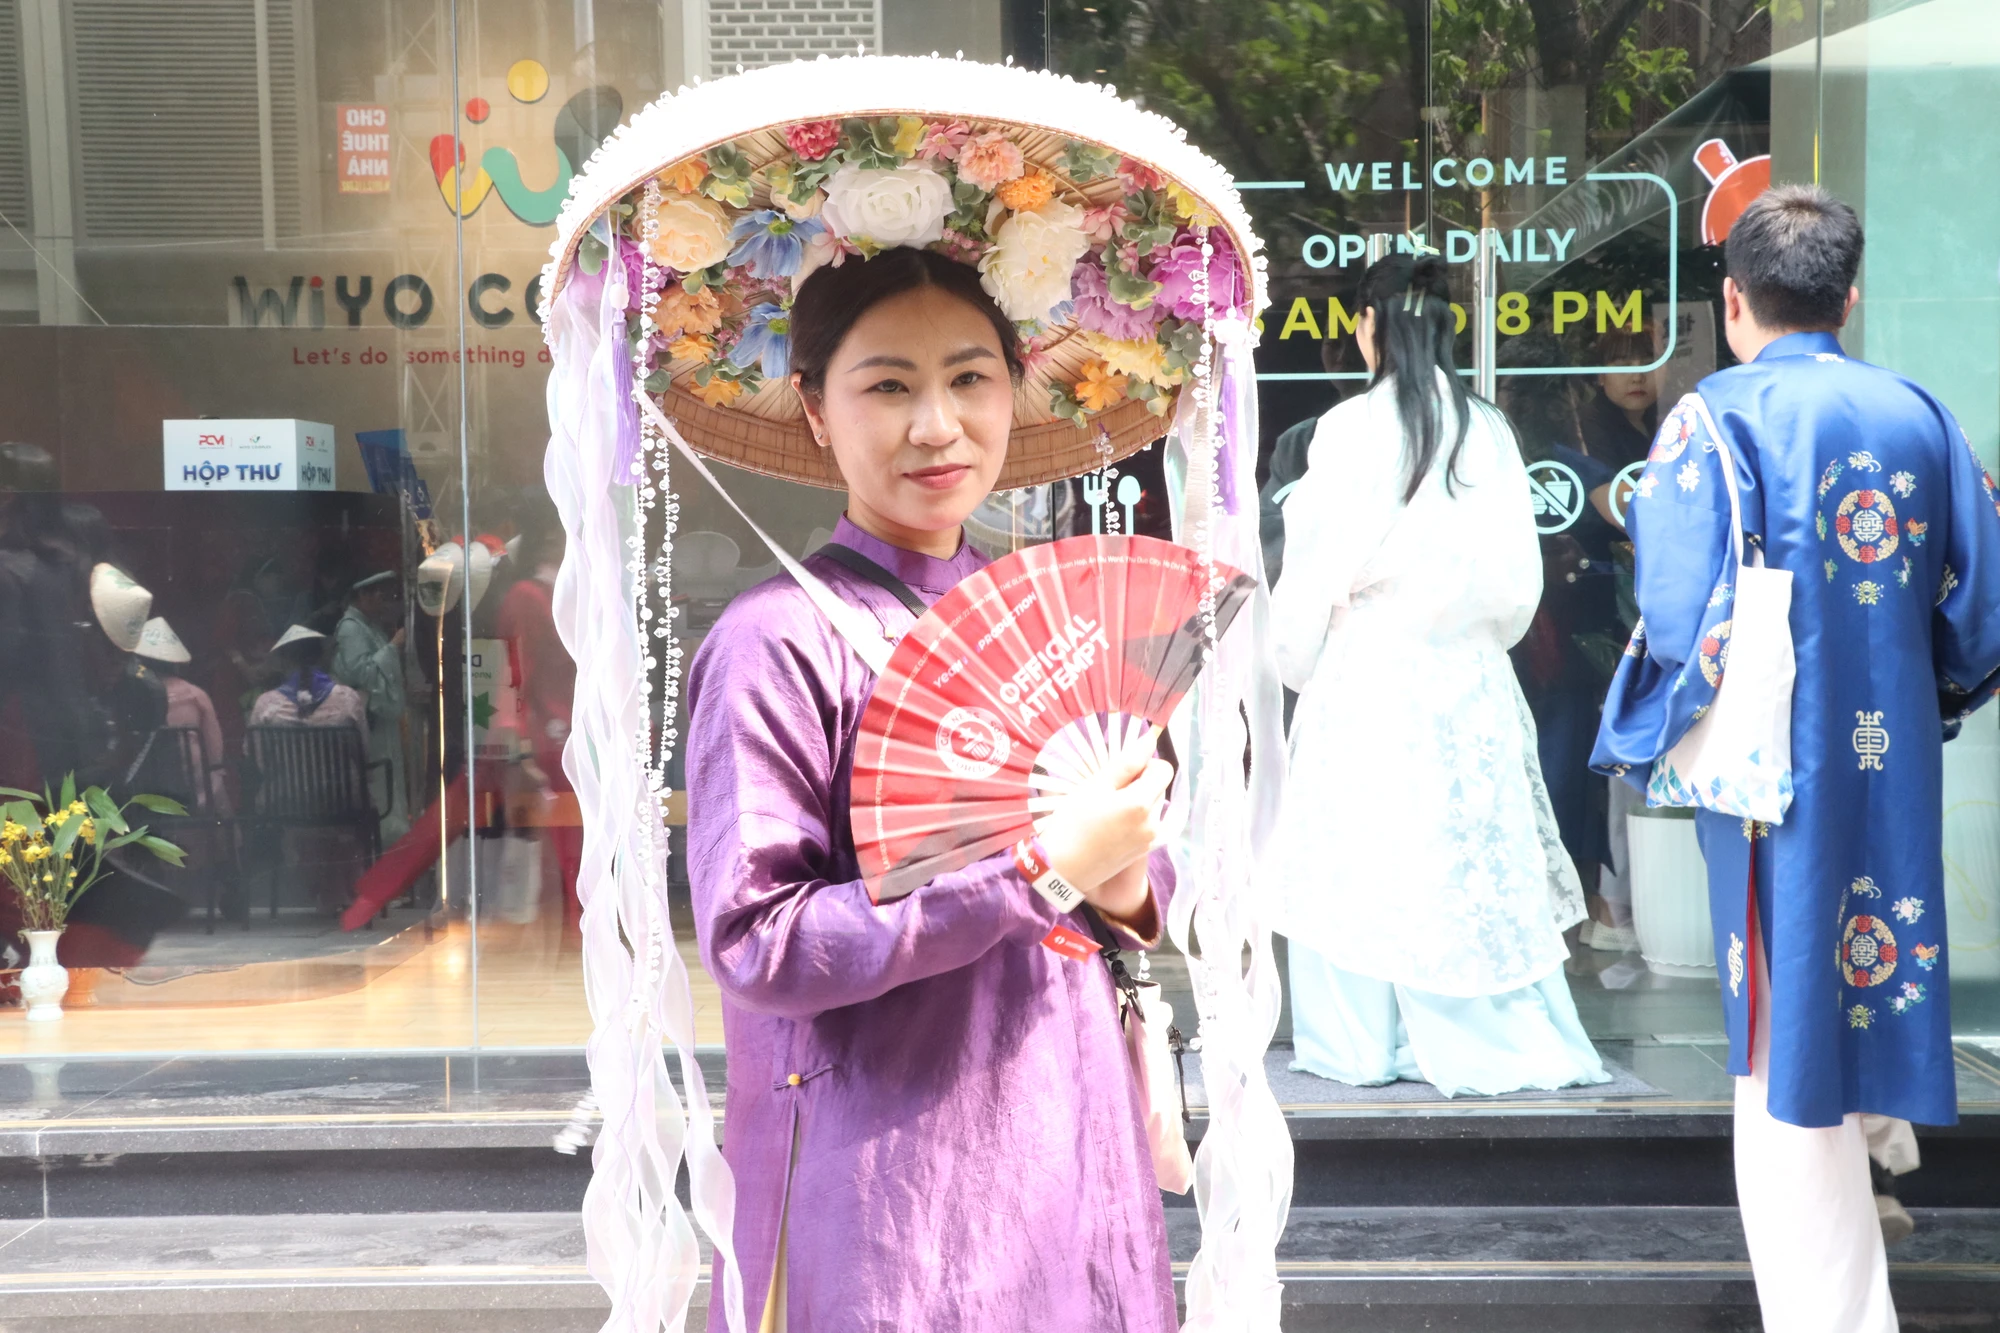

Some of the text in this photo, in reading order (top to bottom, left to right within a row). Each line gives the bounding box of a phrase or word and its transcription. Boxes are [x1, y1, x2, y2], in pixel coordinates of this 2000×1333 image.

[1325, 157, 1567, 191] WELCOME
[1446, 228, 1576, 263] DAILY
[1496, 291, 1531, 336] 8
[1552, 289, 1643, 334] PM
[293, 347, 350, 366] Let's
[360, 346, 388, 365] do
[407, 345, 525, 368] something
[183, 460, 282, 487] HỘP THƯ
[1000, 614, 1097, 704] OFFICIAL
[1018, 627, 1110, 727] ATTEMPT
